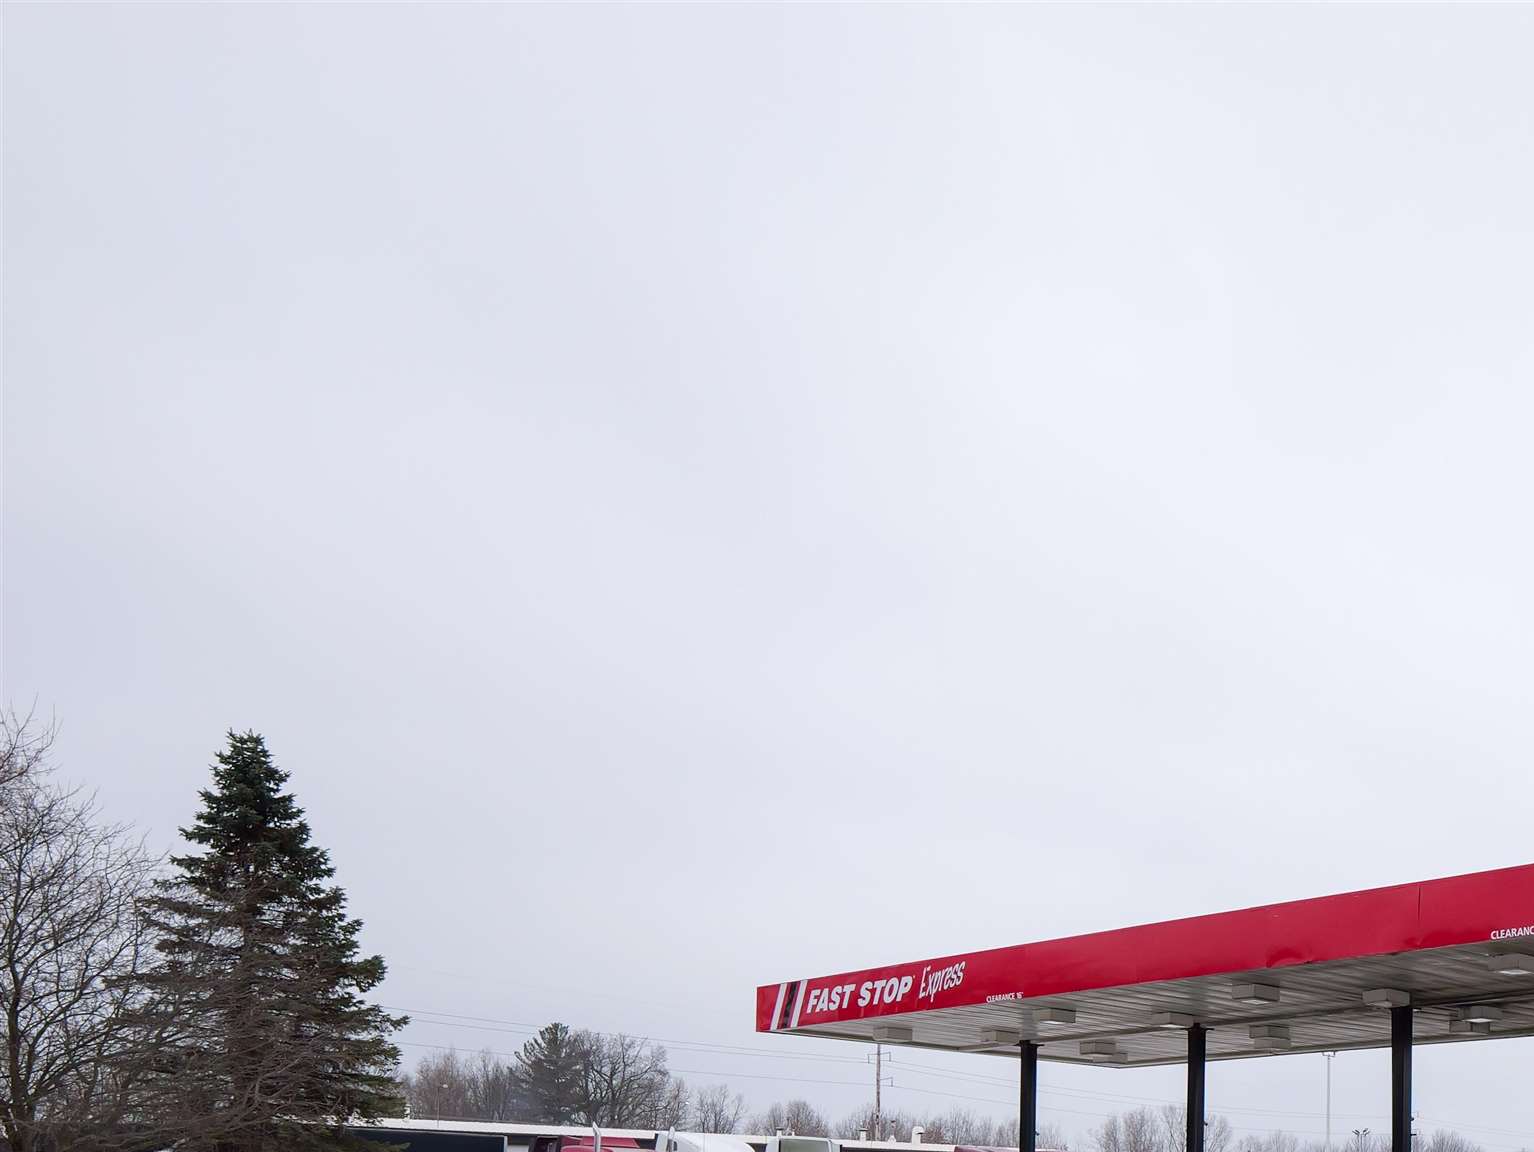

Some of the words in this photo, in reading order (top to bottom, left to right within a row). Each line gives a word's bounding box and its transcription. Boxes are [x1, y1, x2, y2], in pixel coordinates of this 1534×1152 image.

[806, 983, 856, 1014] FAST
[857, 975, 913, 1007] STOP
[918, 960, 966, 1003] Express
[985, 992, 1016, 1003] CLEARANCE
